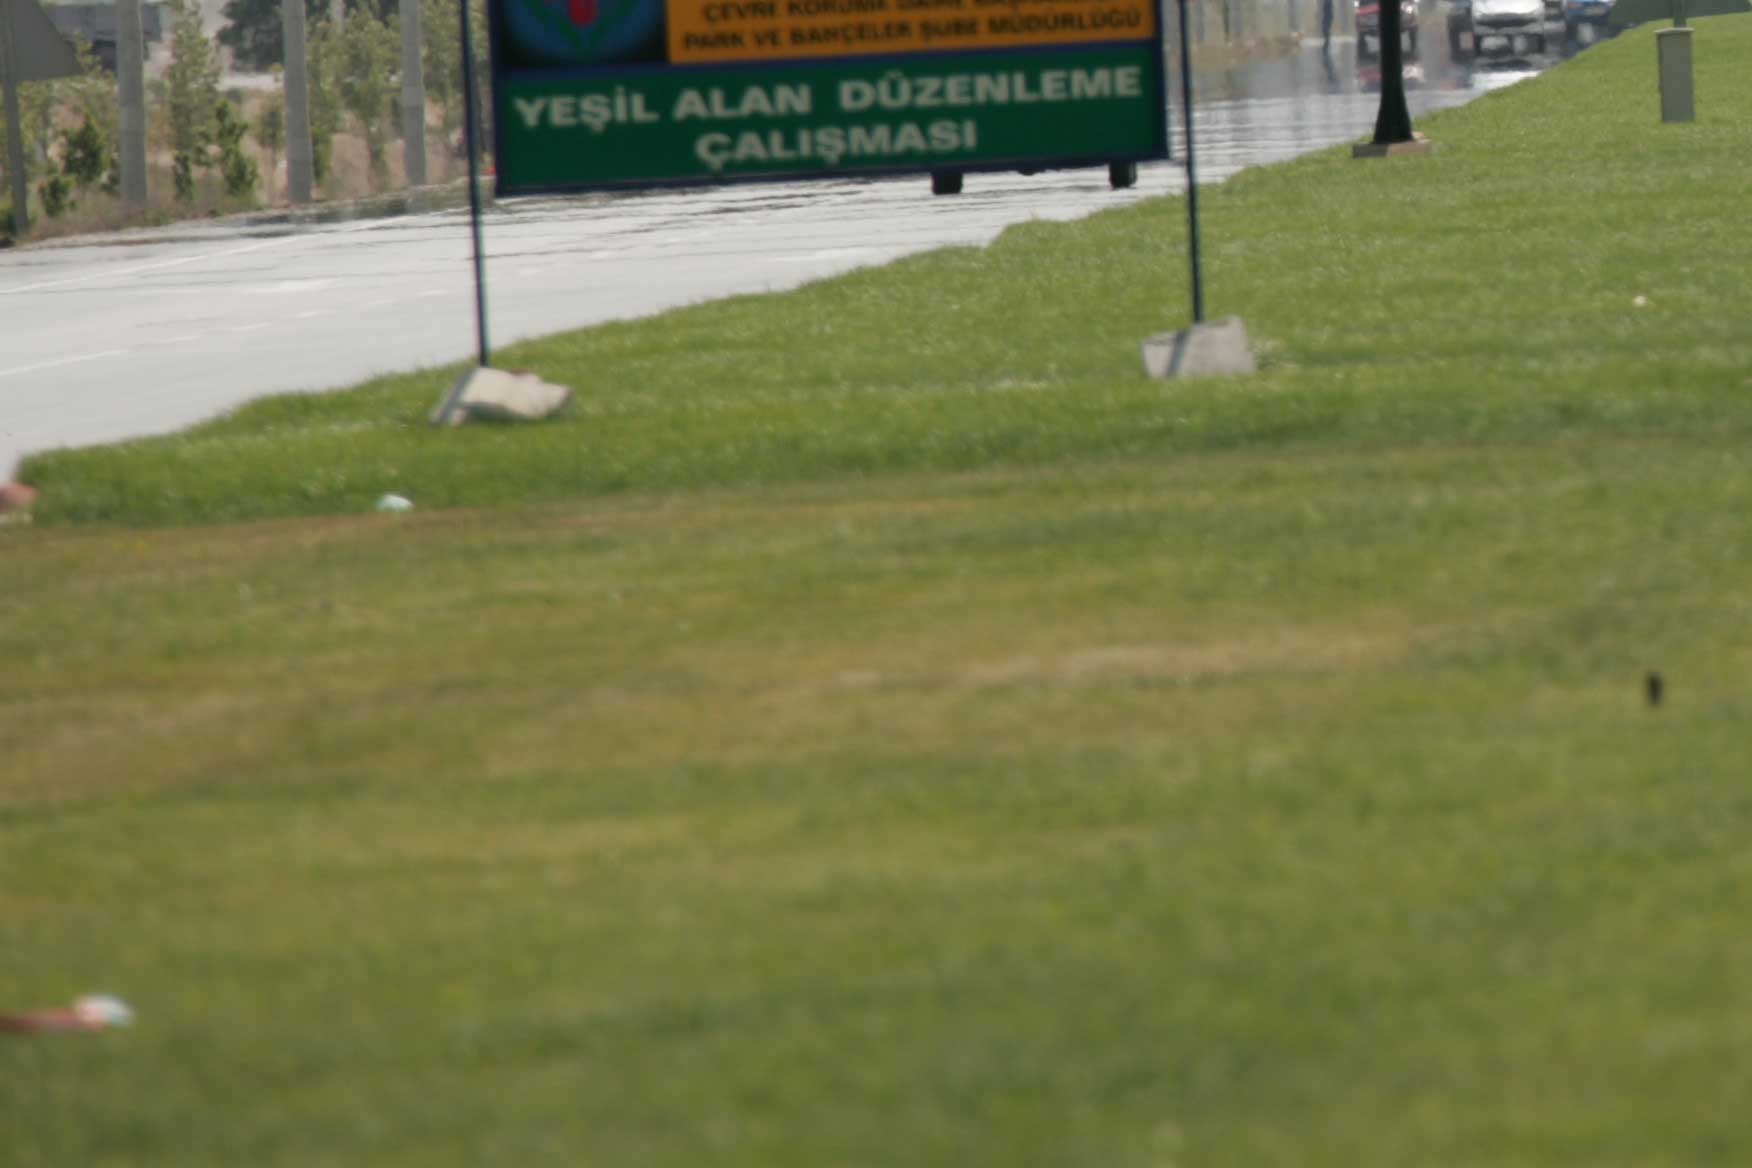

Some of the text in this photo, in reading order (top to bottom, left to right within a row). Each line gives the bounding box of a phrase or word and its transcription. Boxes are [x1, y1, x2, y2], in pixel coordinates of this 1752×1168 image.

[684, 4, 1142, 51] PARK VE BAHÇELER ŞUBE MÜDÜRLÜĞÜ
[512, 66, 1142, 134] YEŞİL ALAN DÜZENLEME
[695, 120, 979, 171] ÇALIŞMASI
